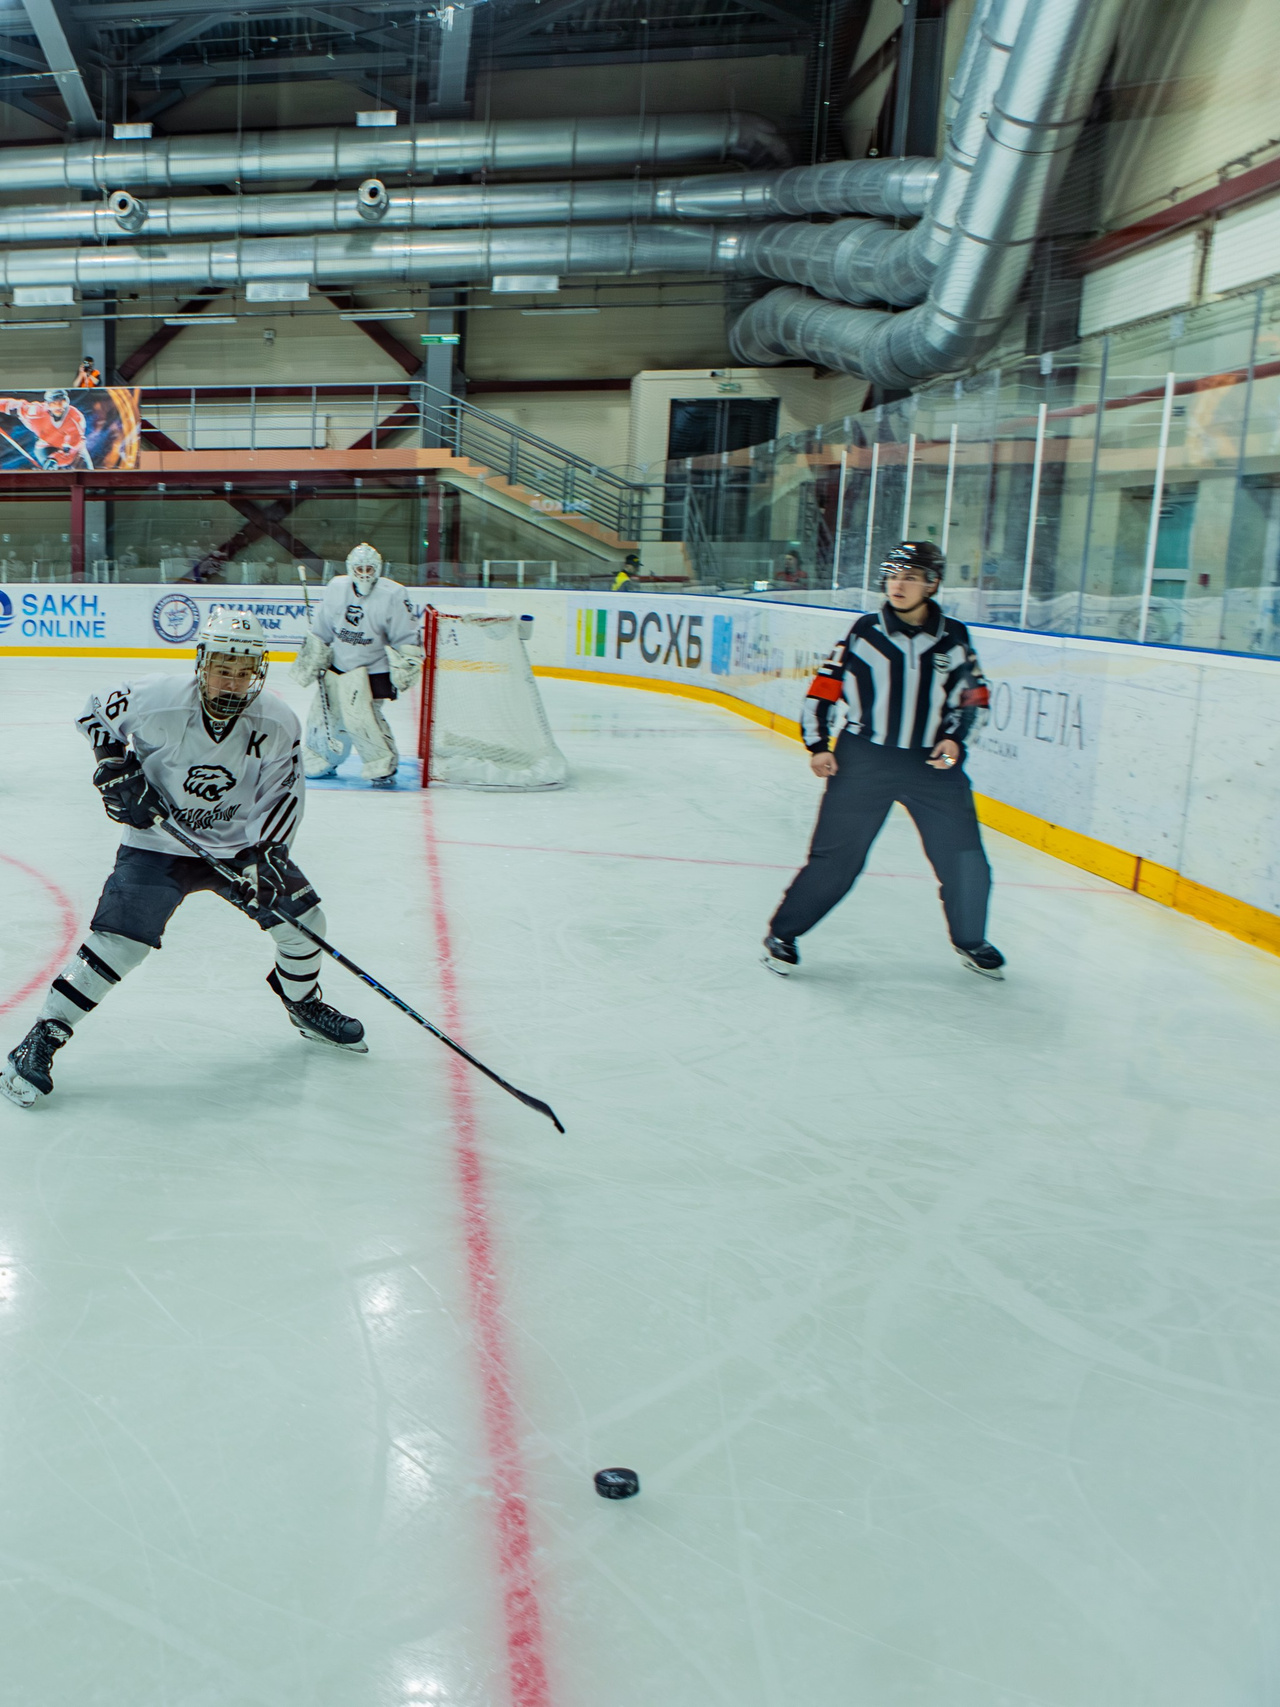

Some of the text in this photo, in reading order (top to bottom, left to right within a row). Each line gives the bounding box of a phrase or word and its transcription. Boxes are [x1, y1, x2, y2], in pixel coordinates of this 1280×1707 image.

[21, 593, 106, 617] SAKH.
[21, 619, 106, 638] ONLINE
[231, 618, 251, 630] 26
[616, 610, 703, 669] РСХБ
[106, 687, 131, 721] 26
